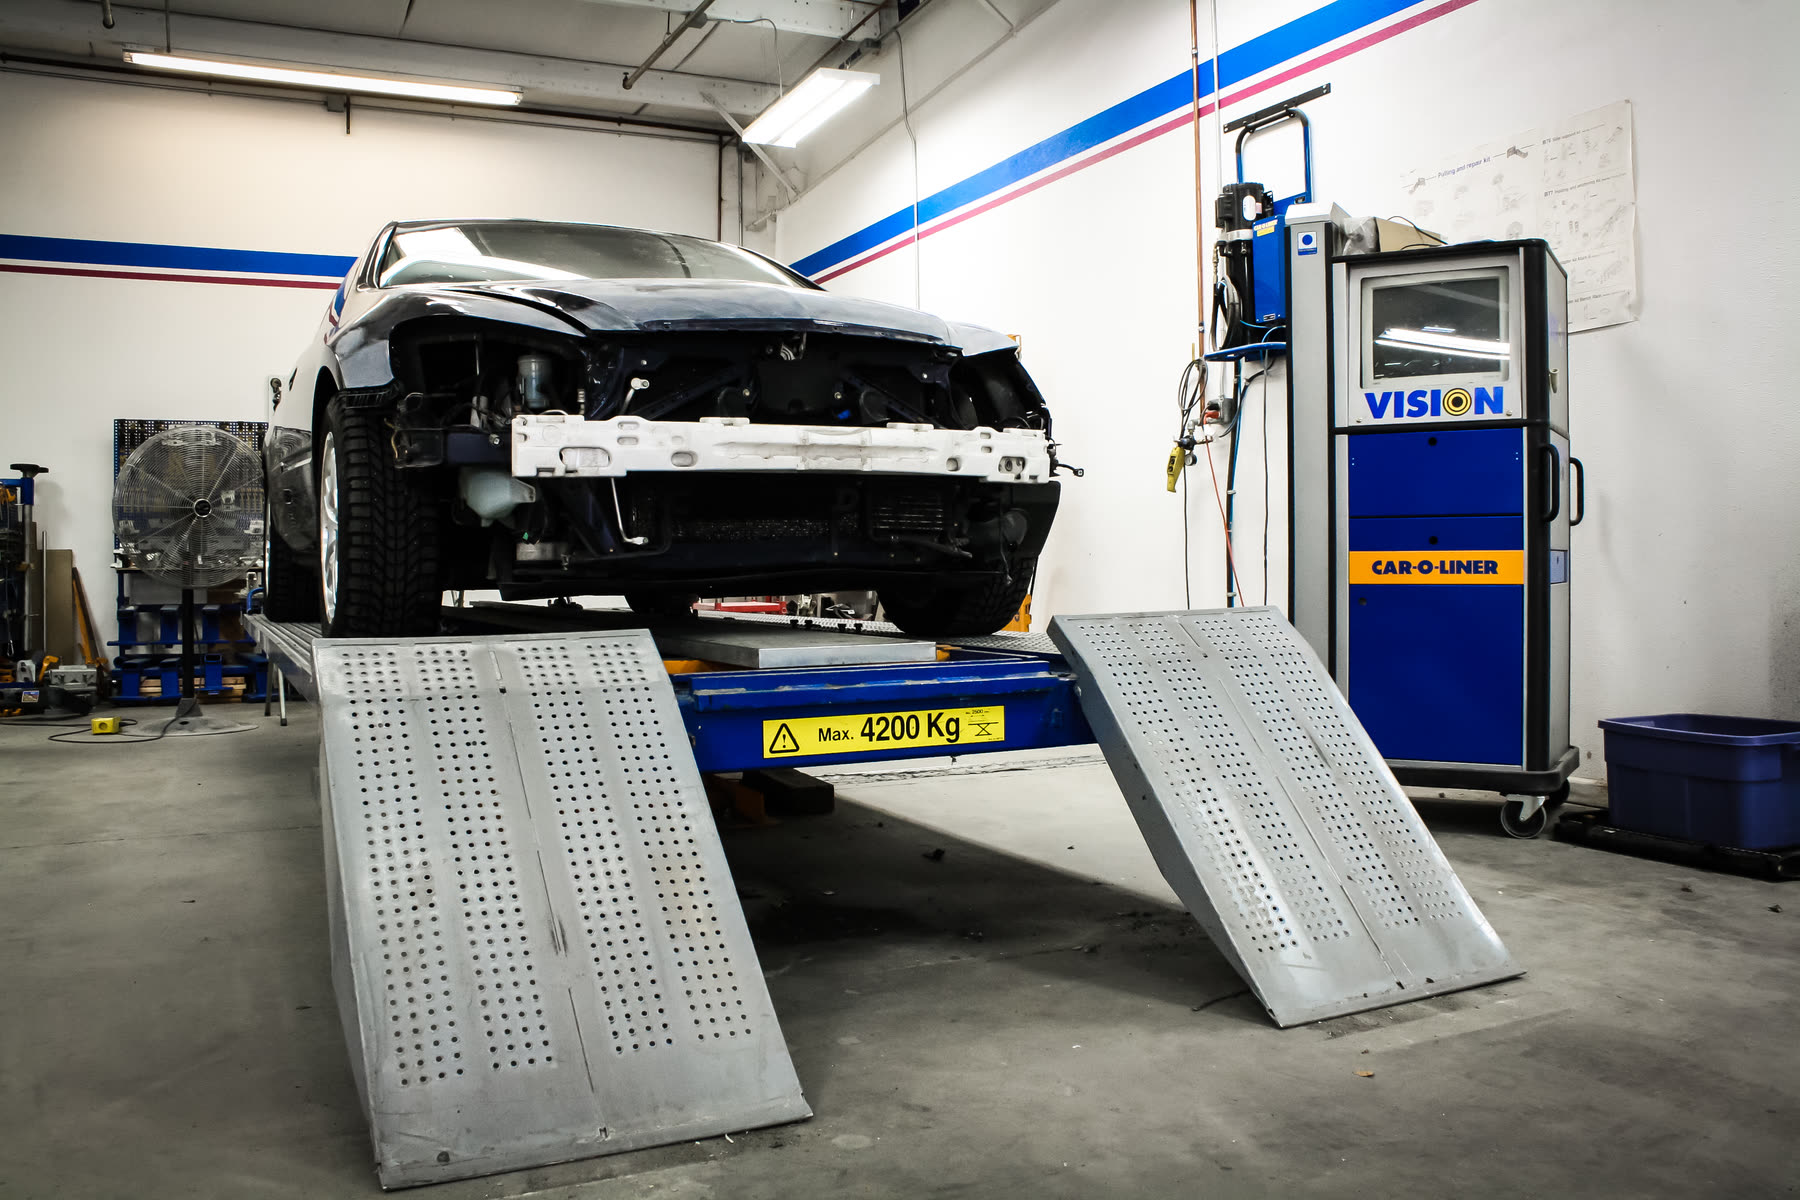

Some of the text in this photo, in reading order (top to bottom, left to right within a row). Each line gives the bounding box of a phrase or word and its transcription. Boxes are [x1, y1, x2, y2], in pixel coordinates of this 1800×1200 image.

[1438, 169, 1456, 178] Pulling
[1456, 165, 1466, 173] and
[1467, 160, 1482, 168] repair
[1365, 386, 1504, 419] VISION
[1372, 560, 1498, 575] CAR-O-LINER
[818, 712, 960, 743] Max. 4200 Kg
